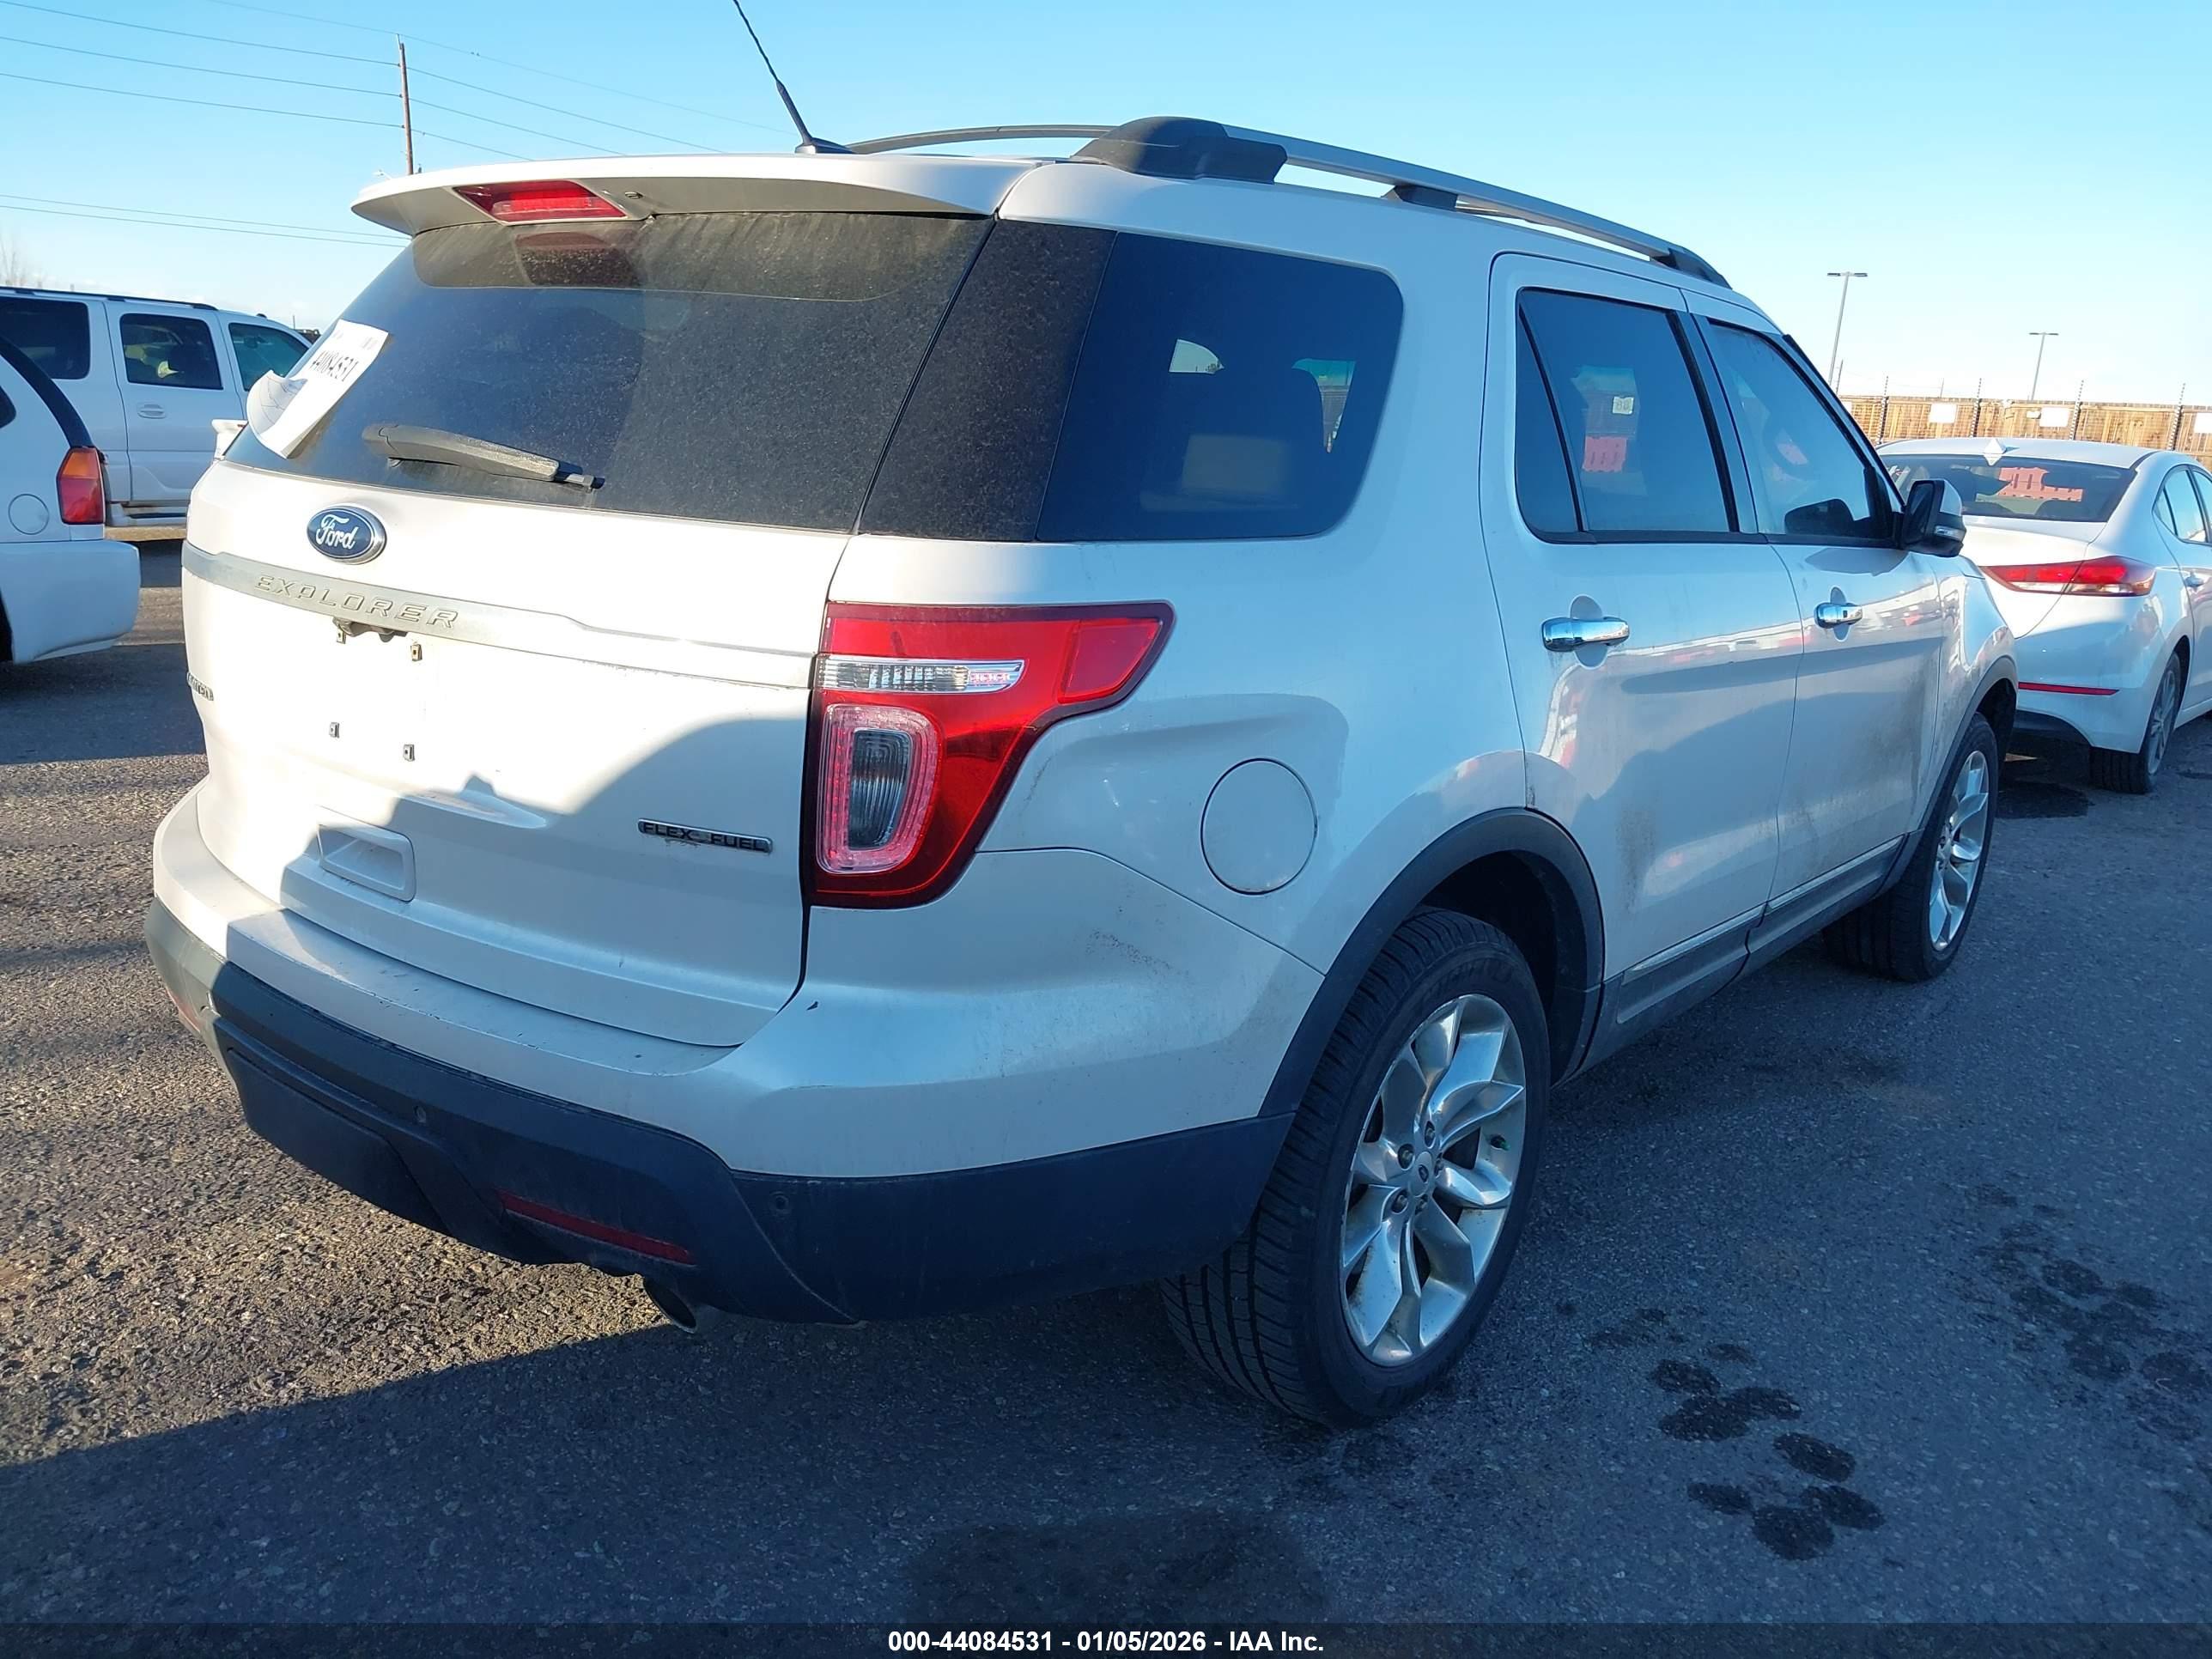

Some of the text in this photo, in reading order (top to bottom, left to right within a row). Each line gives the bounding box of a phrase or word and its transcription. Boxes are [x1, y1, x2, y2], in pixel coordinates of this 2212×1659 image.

[315, 514, 359, 550] Ford
[255, 575, 459, 629] EXPLORER
[643, 822, 767, 852] FLEX FUEL
